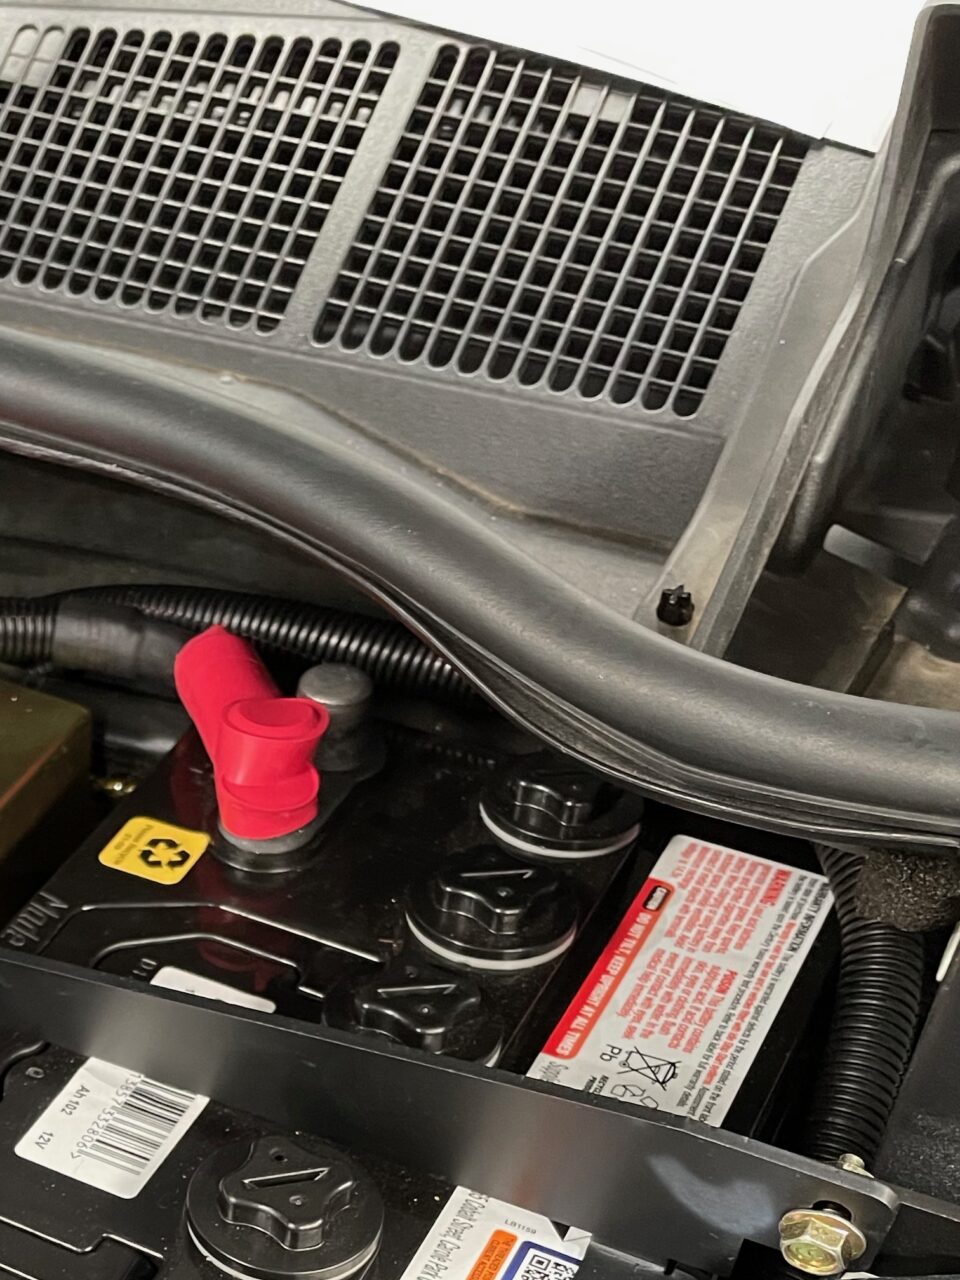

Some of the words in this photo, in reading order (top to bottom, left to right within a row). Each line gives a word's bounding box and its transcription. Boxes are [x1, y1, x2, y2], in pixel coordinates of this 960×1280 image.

[0, 892, 68, 946] Made
[626, 922, 646, 938] NOT
[602, 954, 628, 976] KEEP
[584, 973, 616, 1007] UPRIGHT
[577, 1004, 598, 1018] AT
[569, 1015, 592, 1032] ALL
[553, 1029, 582, 1056] TIMES
[598, 1043, 623, 1063] Pb
[71, 1084, 91, 1099] Ah
[58, 1098, 80, 1115] 102
[31, 1130, 55, 1150] 12V
